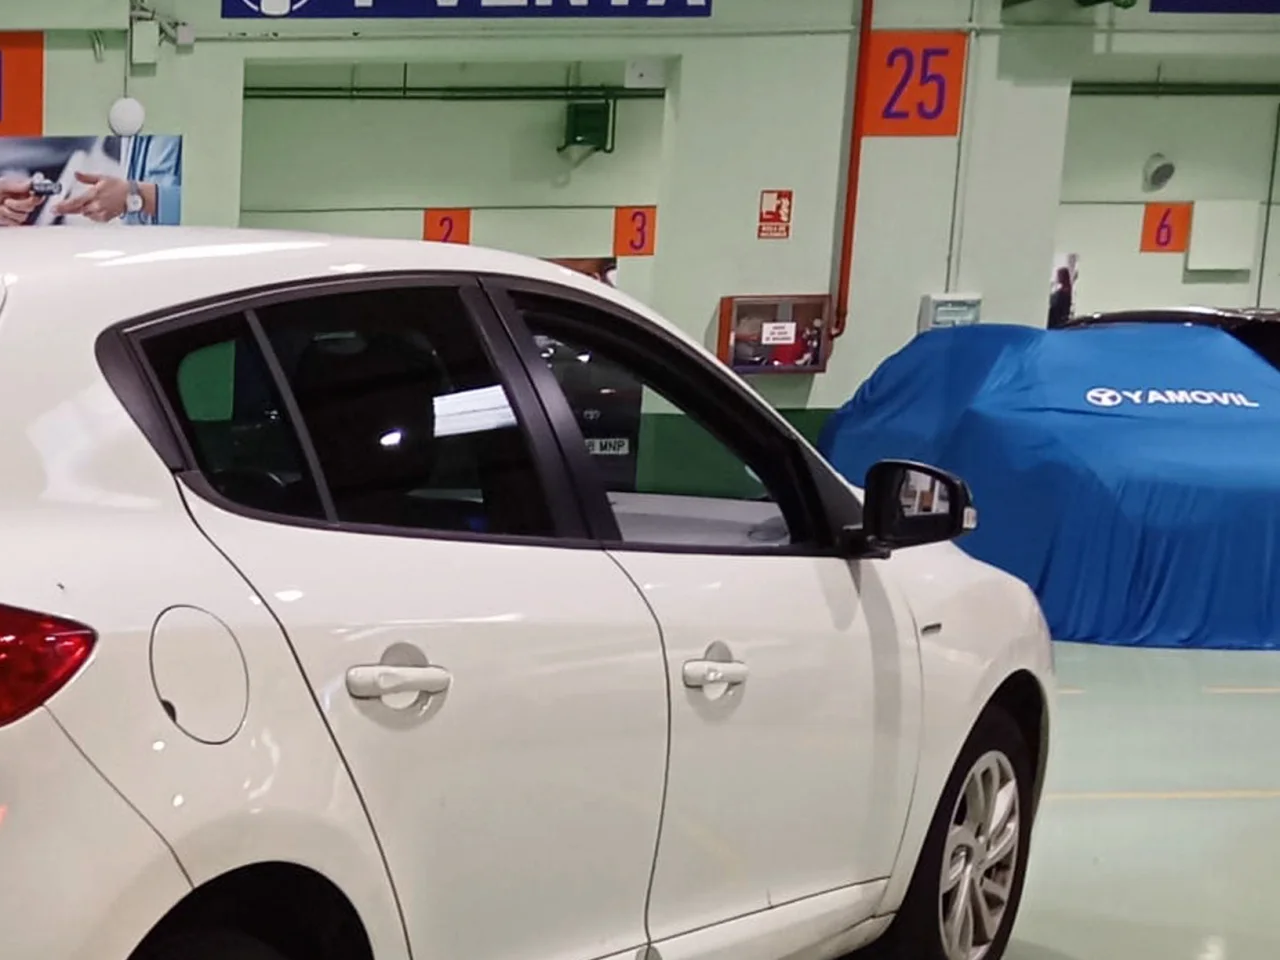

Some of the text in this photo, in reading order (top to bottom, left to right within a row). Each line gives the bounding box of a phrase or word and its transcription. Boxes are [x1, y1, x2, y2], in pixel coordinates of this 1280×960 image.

[881, 46, 950, 121] 25
[439, 216, 454, 243] 2
[629, 211, 647, 250] 3
[1155, 207, 1172, 248] 6
[1121, 389, 1260, 408] YAMOVIL
